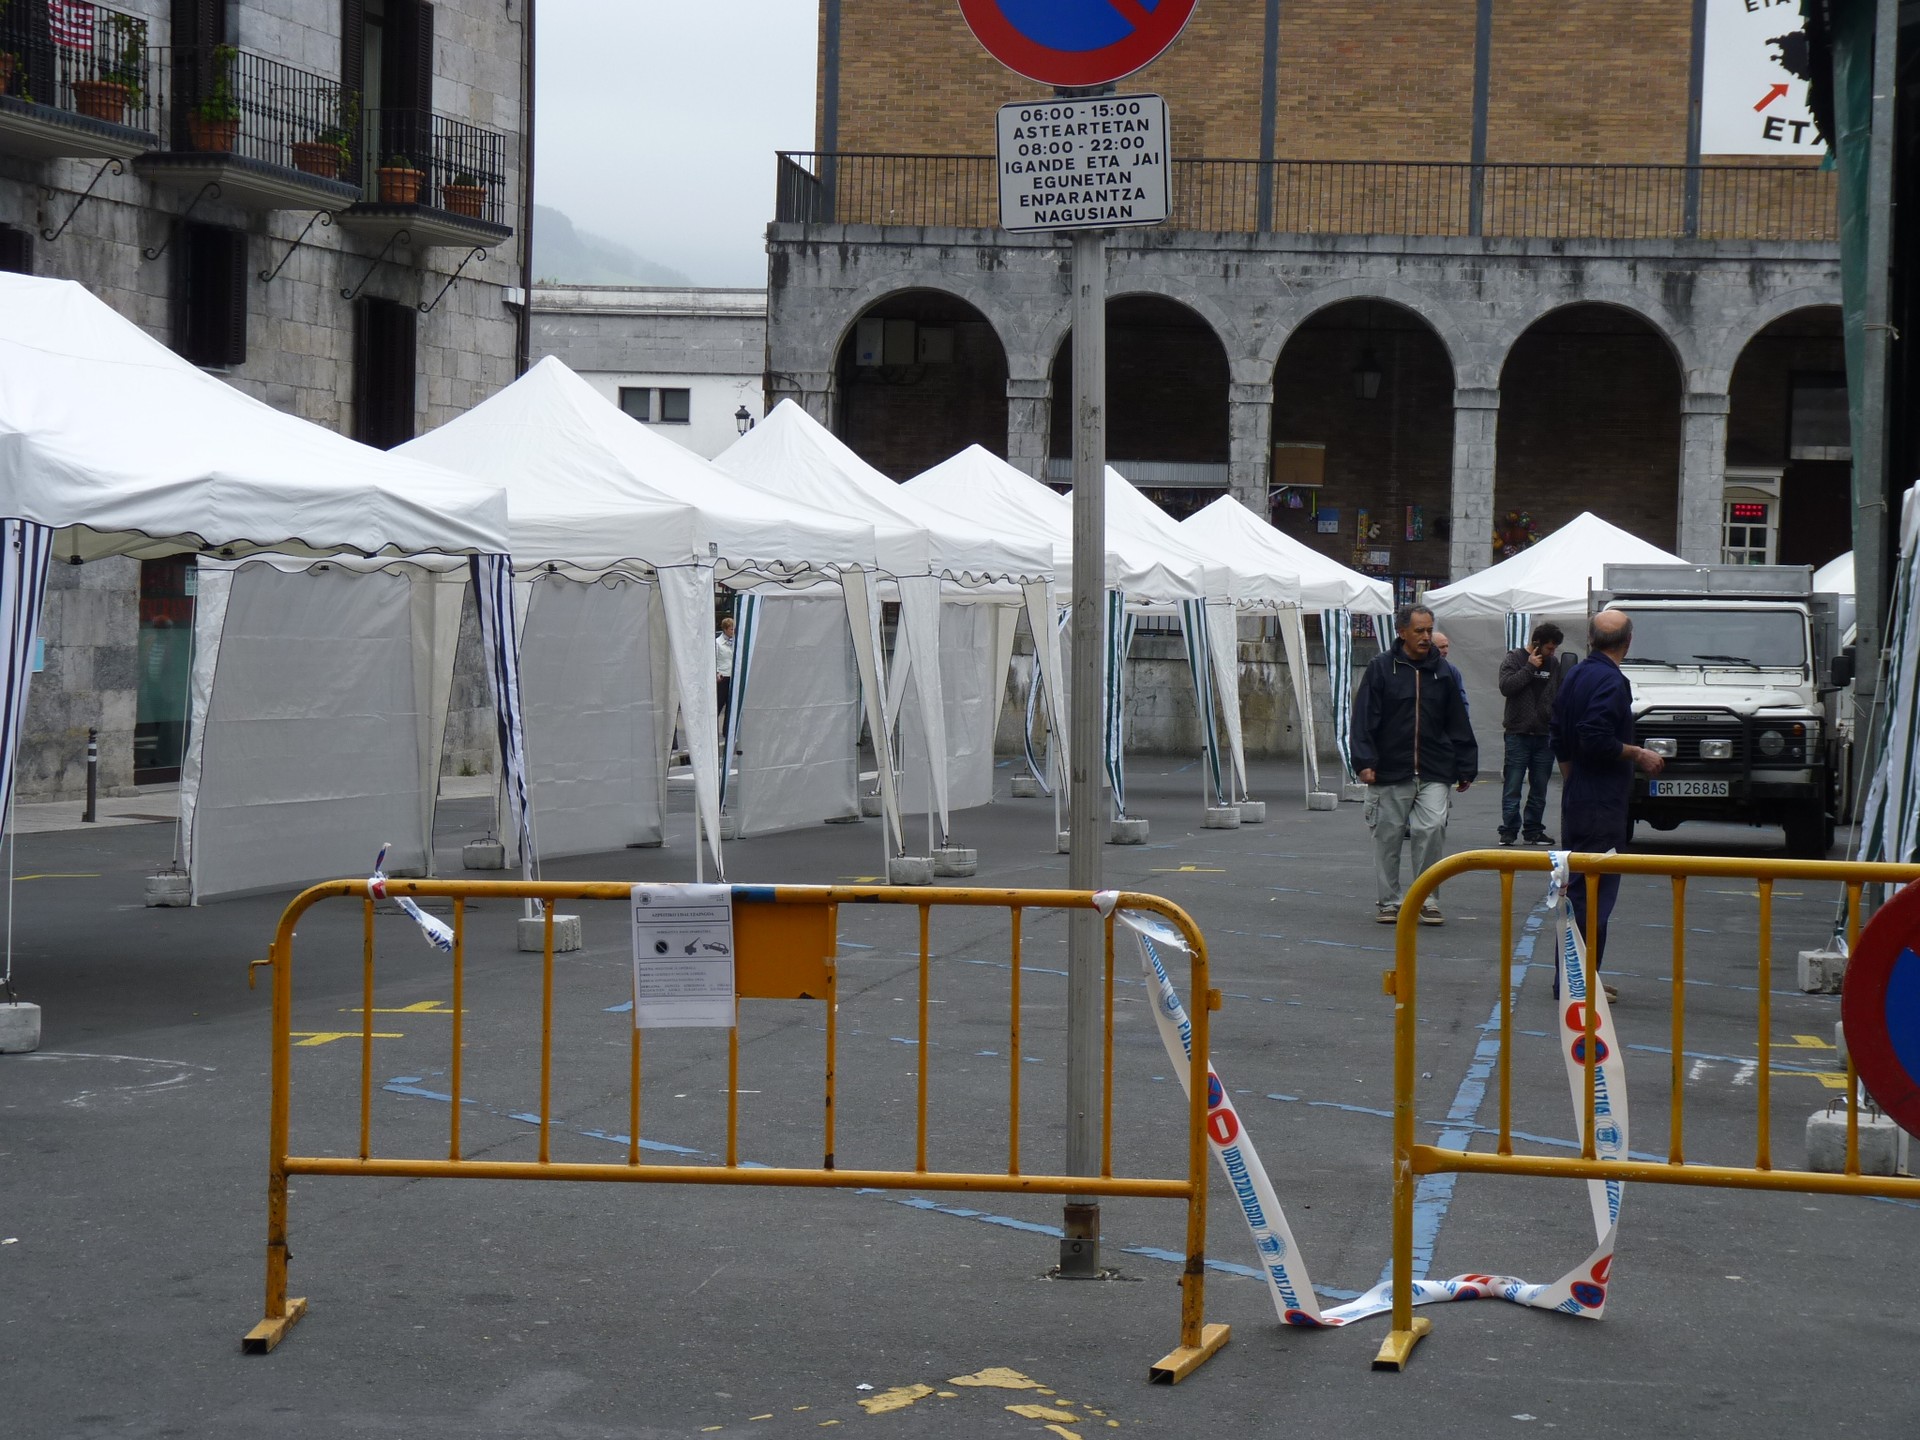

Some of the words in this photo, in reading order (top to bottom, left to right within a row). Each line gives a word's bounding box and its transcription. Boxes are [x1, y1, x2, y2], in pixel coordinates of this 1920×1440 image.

[1020, 107, 1074, 122] 06:00
[1091, 102, 1140, 117] 15:00
[1013, 118, 1150, 140] ASTEARTETAN
[1018, 141, 1073, 156] 08:00
[1090, 136, 1145, 152] 22:00
[1005, 158, 1075, 174] IGANDE
[1087, 155, 1120, 169] ETA
[1132, 152, 1159, 166] JAI
[1033, 171, 1132, 189] EGUNETAN
[1020, 187, 1146, 207] ENPARANTZA
[1034, 205, 1132, 223] NAGUSIAN
